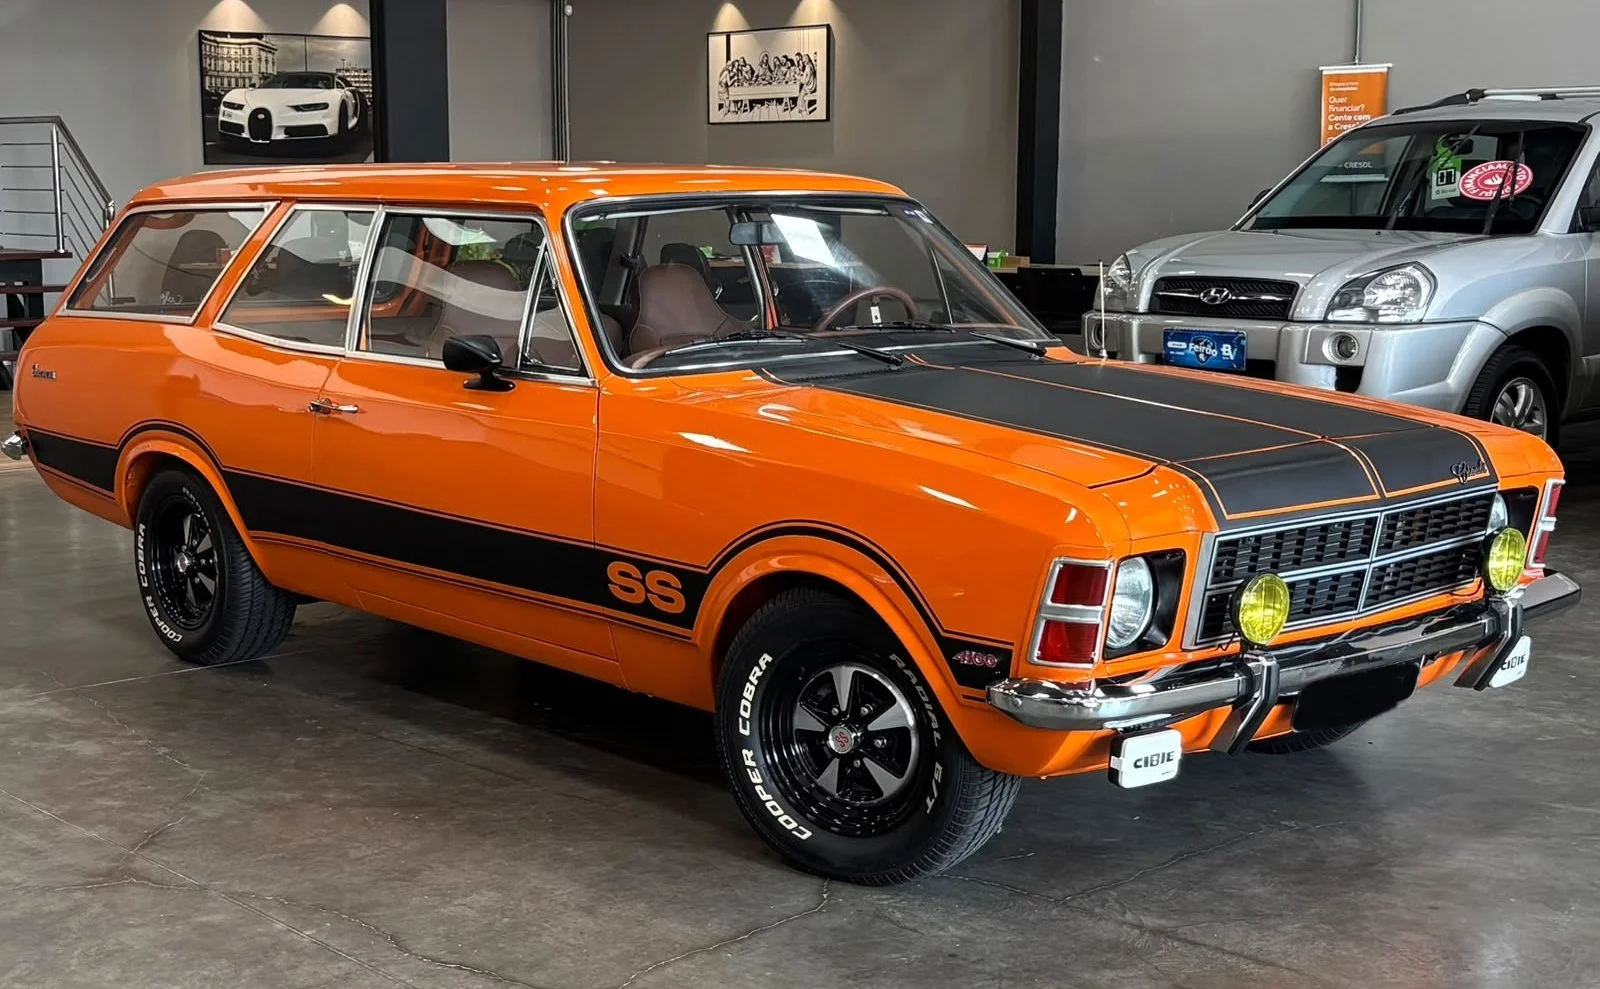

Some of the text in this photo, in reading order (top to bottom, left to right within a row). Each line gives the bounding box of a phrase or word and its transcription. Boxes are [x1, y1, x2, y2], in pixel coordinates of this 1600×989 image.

[1328, 96, 1348, 104] Quer
[138, 523, 183, 643] COOPER COBRA
[607, 561, 686, 613] SS
[738, 653, 813, 841] COOPER COBRA
[889, 653, 942, 747] RADIAL
